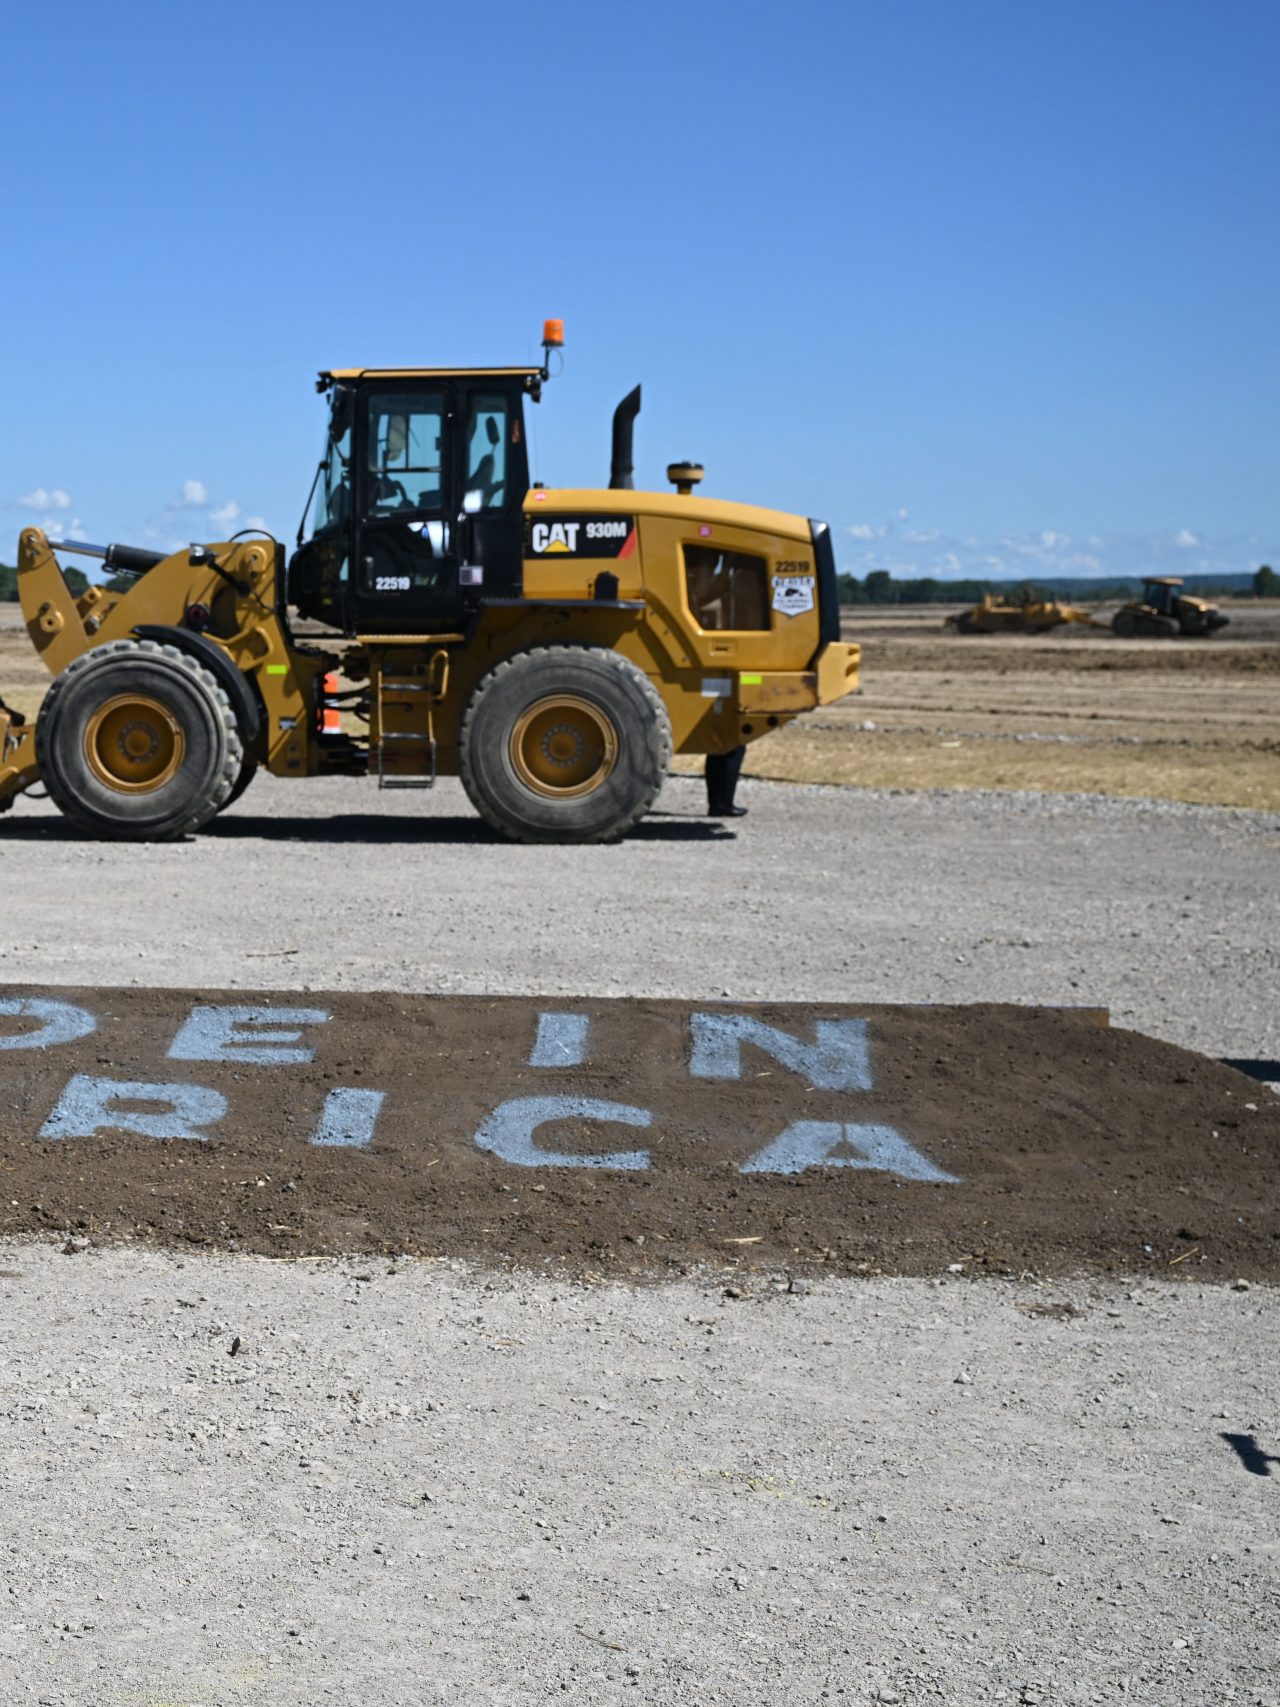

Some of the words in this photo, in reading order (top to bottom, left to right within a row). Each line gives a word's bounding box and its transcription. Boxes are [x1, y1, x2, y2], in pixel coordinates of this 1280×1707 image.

[532, 522, 580, 553] CAT
[585, 521, 627, 539] 930M
[775, 560, 810, 573] 22519
[375, 576, 411, 591] 22519
[528, 1011, 874, 1092] IN
